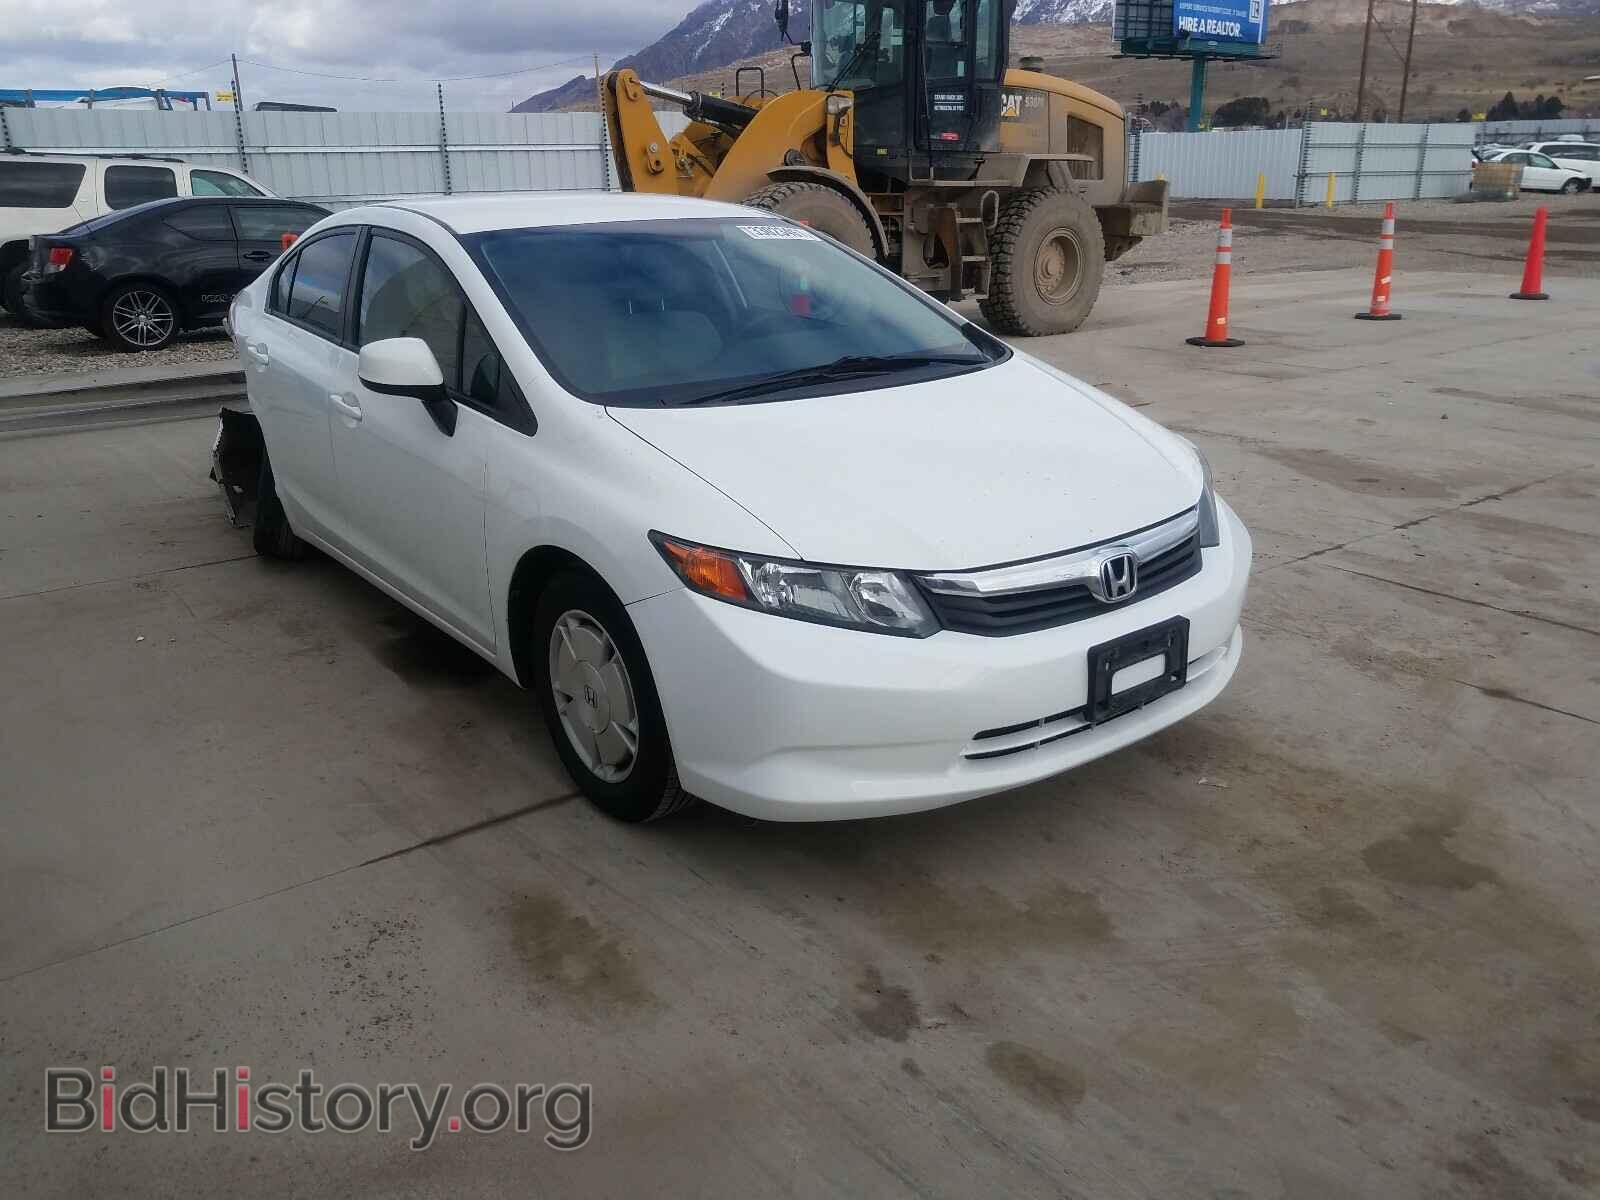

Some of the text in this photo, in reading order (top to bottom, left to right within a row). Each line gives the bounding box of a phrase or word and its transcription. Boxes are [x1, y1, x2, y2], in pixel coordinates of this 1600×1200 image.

[1179, 15, 1198, 32] HIRE
[1198, 19, 1206, 32] A
[1001, 94, 1022, 117] CAT
